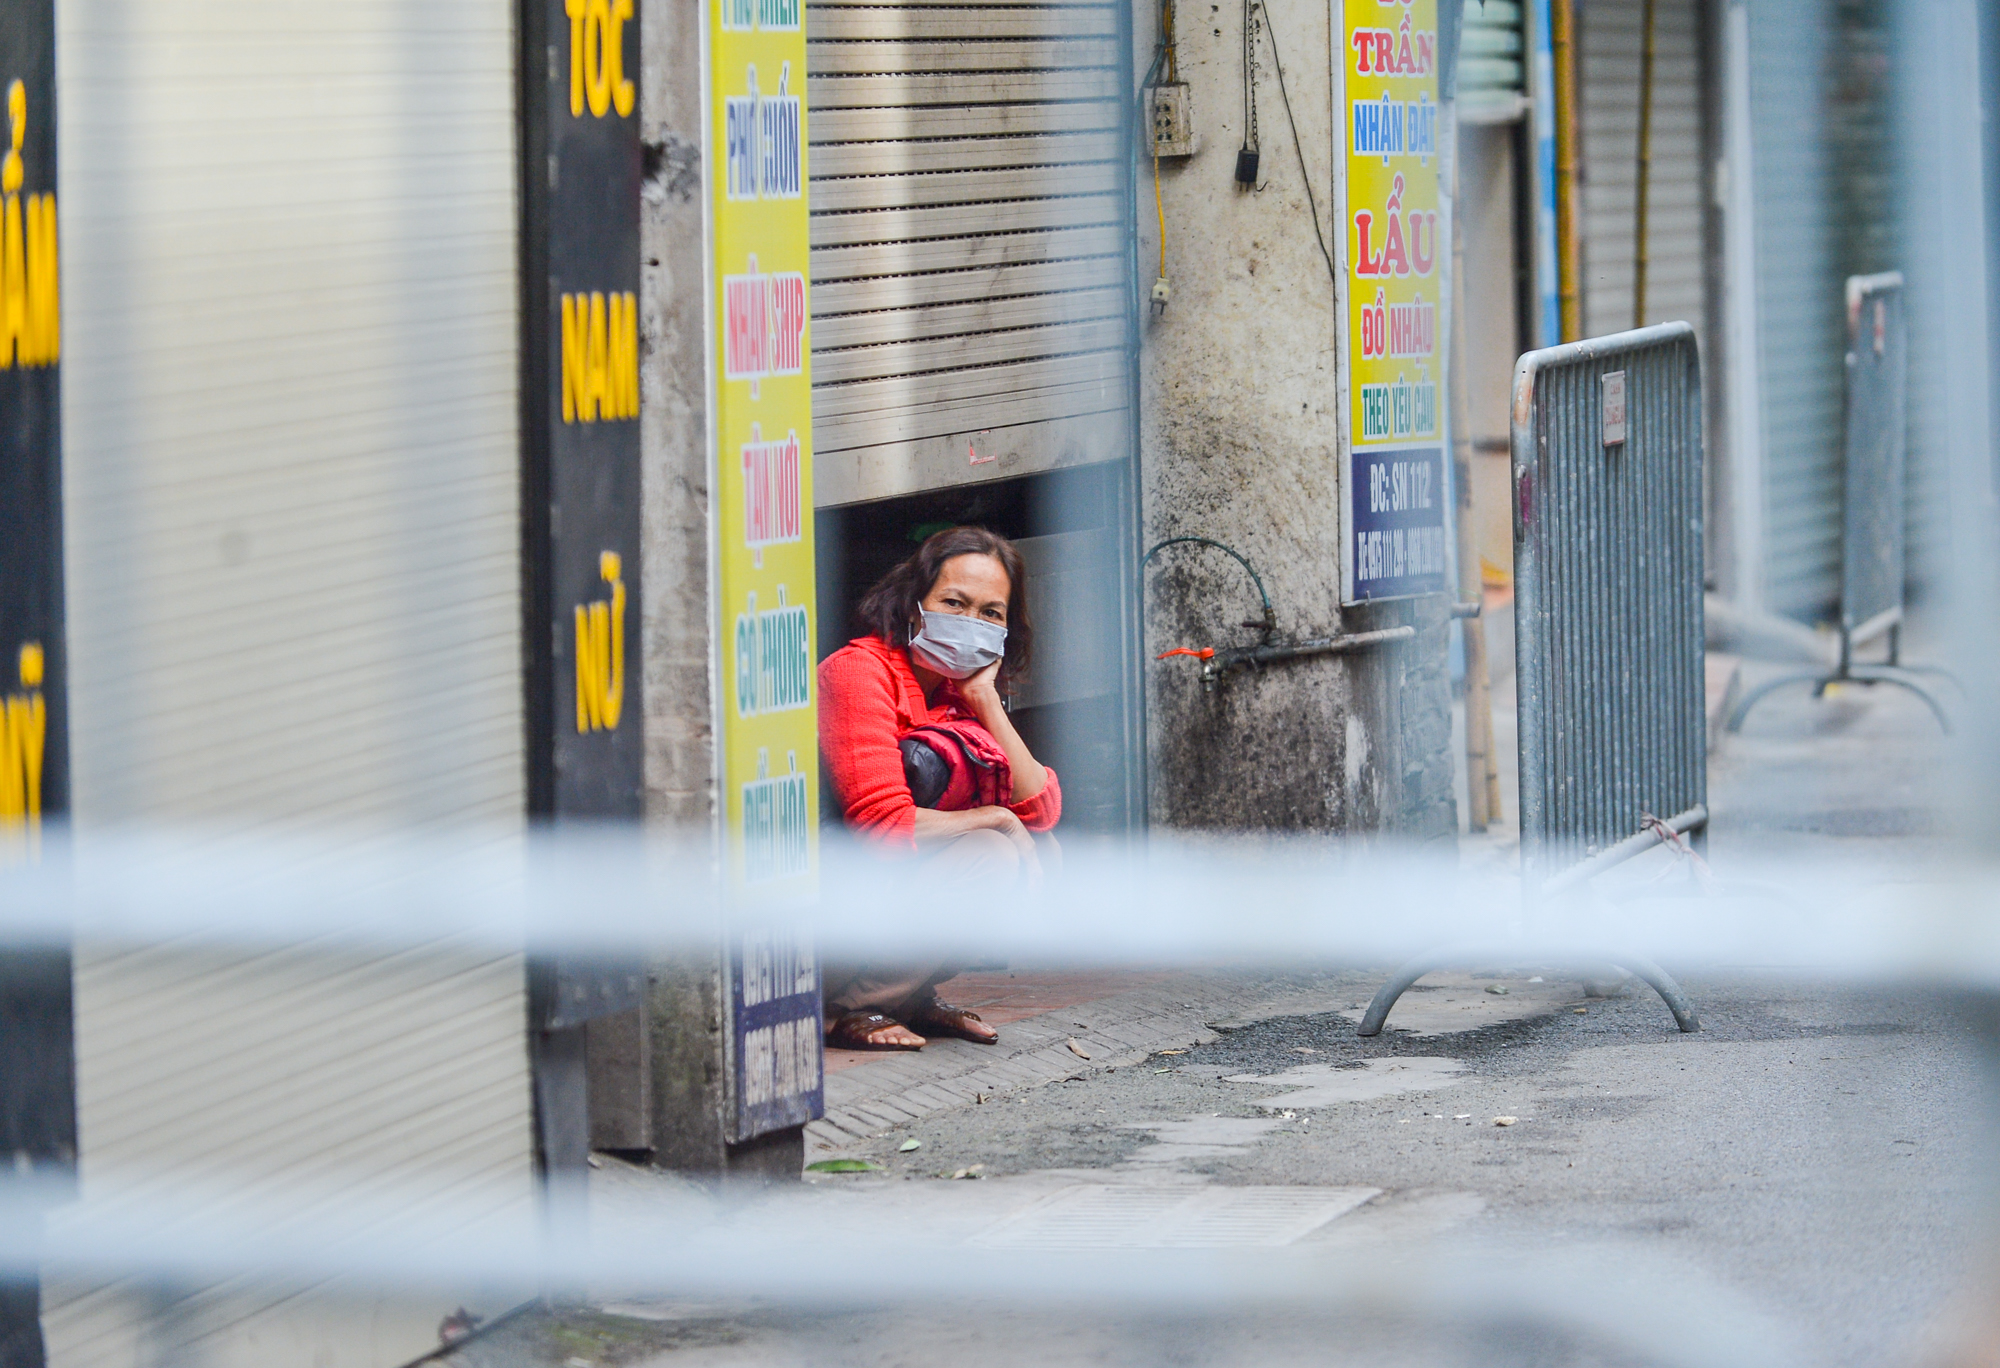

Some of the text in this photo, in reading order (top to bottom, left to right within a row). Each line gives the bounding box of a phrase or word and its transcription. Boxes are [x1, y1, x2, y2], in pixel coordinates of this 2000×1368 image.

[1354, 13, 1435, 73] TRẦN
[760, 65, 799, 193] CUỐN
[1355, 95, 1436, 163] NHẬN ĐẶT
[0, 79, 60, 369] ẨM
[1356, 175, 1435, 274] LẨU
[562, 291, 639, 424] NAM
[771, 277, 803, 371] SHIP
[1362, 291, 1434, 364] ĐỒ NHẬU
[1363, 368, 1435, 435] THEO YÊU CẦU
[775, 434, 799, 538] NƠI
[1370, 461, 1431, 512] ĐC: SN 112
[575, 550, 626, 734] NỮ
[737, 590, 808, 712] CÓ PHÒNG
[868, 1014, 883, 1022] VIP
